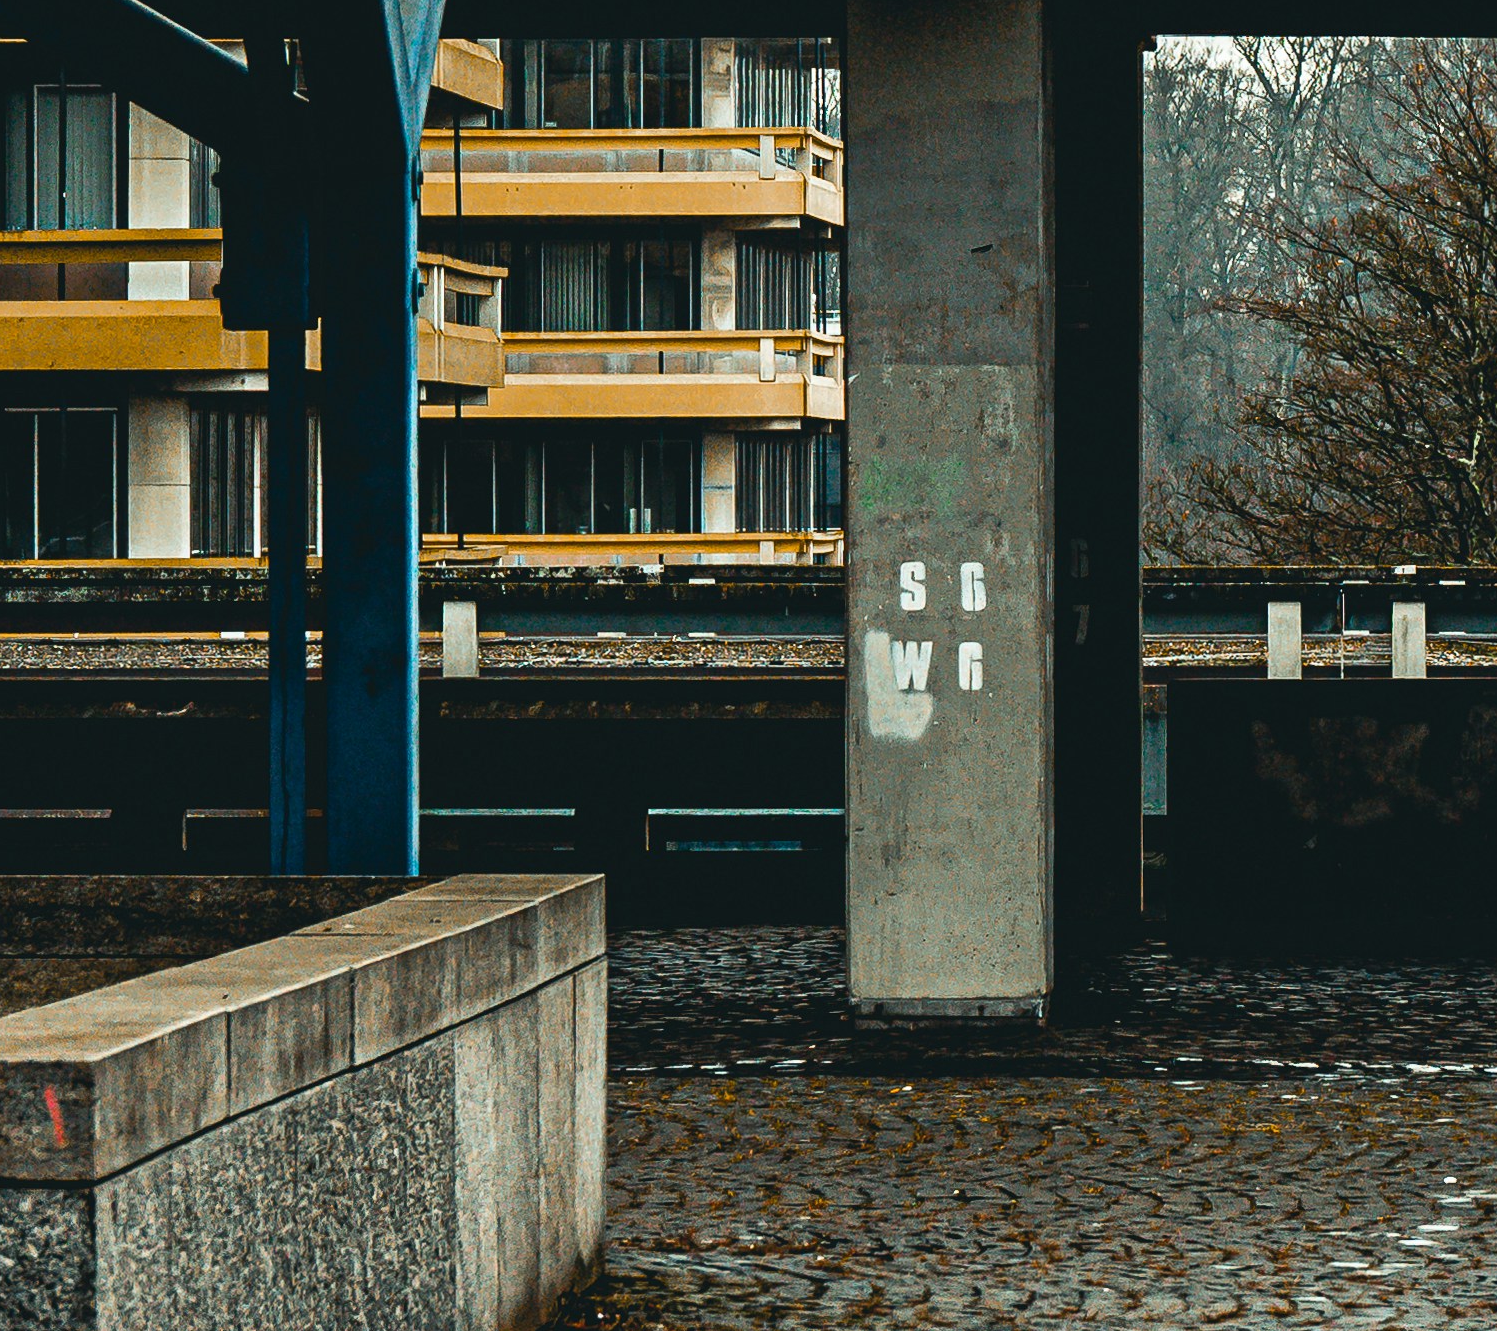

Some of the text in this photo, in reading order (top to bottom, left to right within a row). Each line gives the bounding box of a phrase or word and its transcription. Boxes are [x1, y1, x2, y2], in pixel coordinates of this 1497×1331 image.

[900, 561, 987, 612] S 6
[890, 641, 984, 691] W 6
